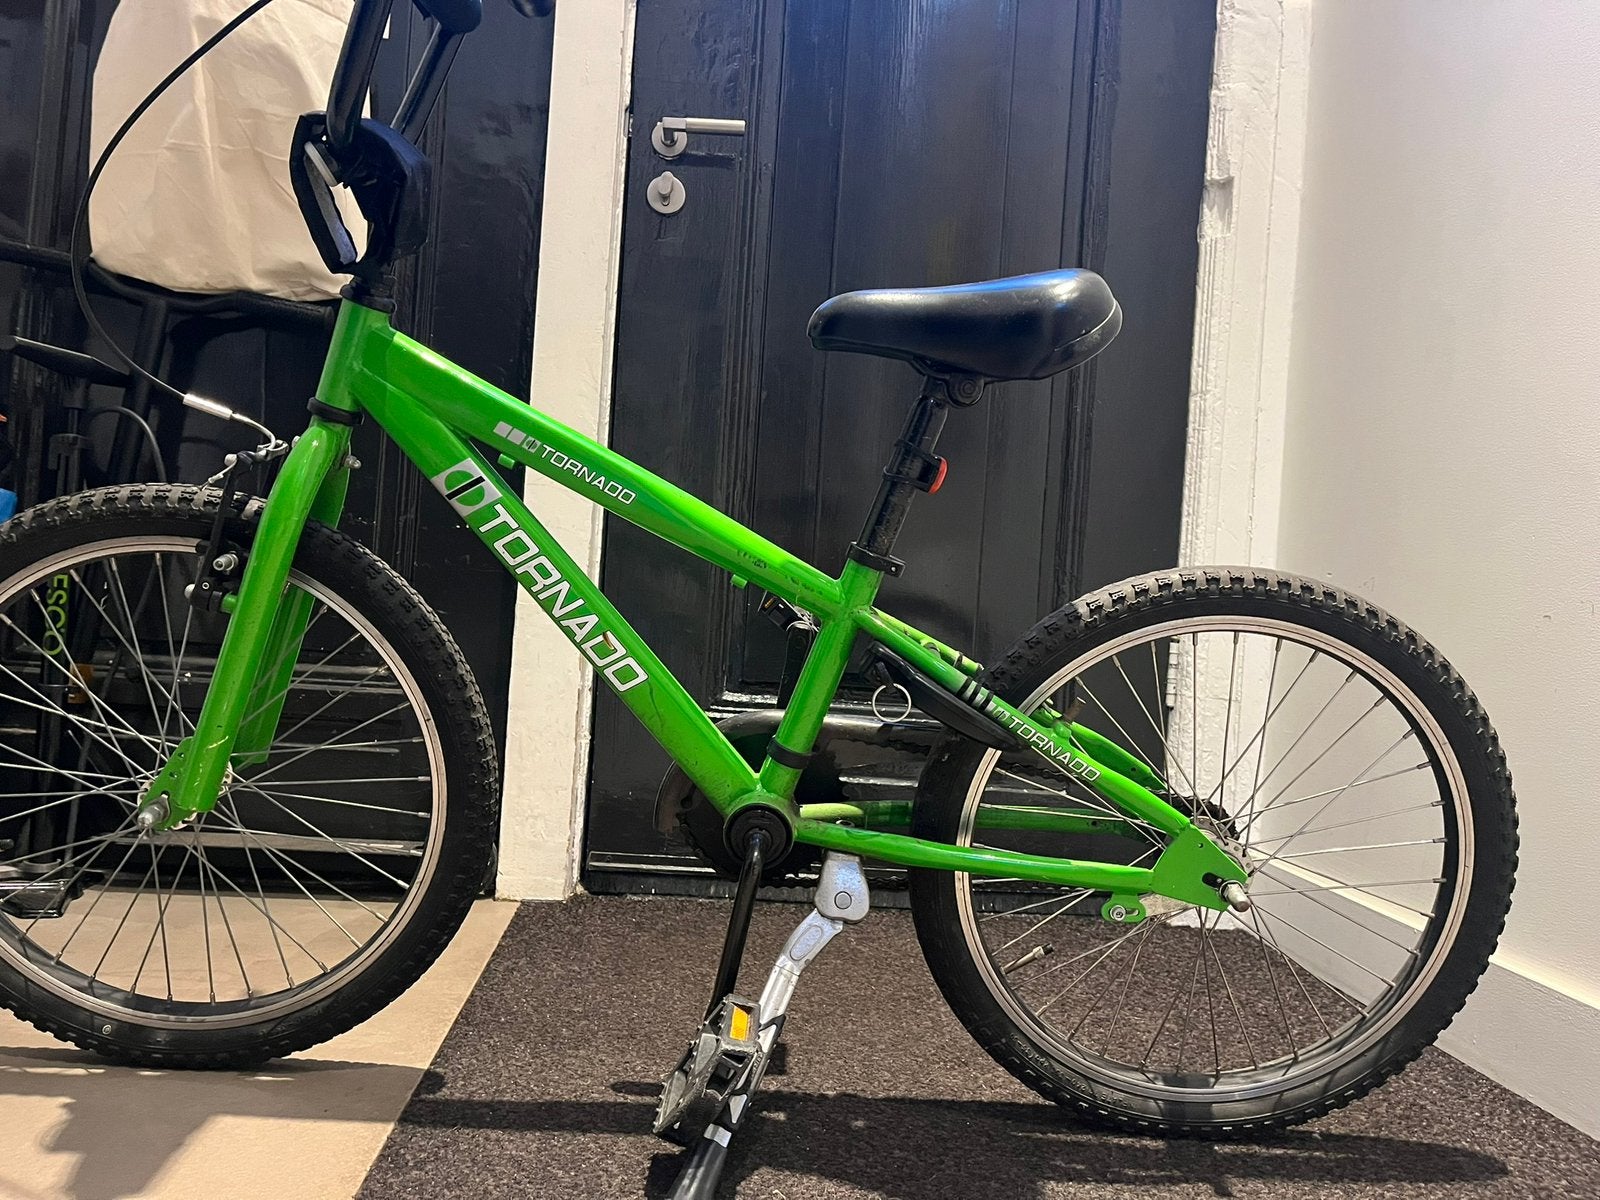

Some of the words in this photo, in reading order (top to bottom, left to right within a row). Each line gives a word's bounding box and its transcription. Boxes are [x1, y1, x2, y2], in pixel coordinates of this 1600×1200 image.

[540, 444, 637, 505] TORNADO
[478, 503, 650, 692] TORNADO
[1008, 715, 1102, 781] TORNADO
